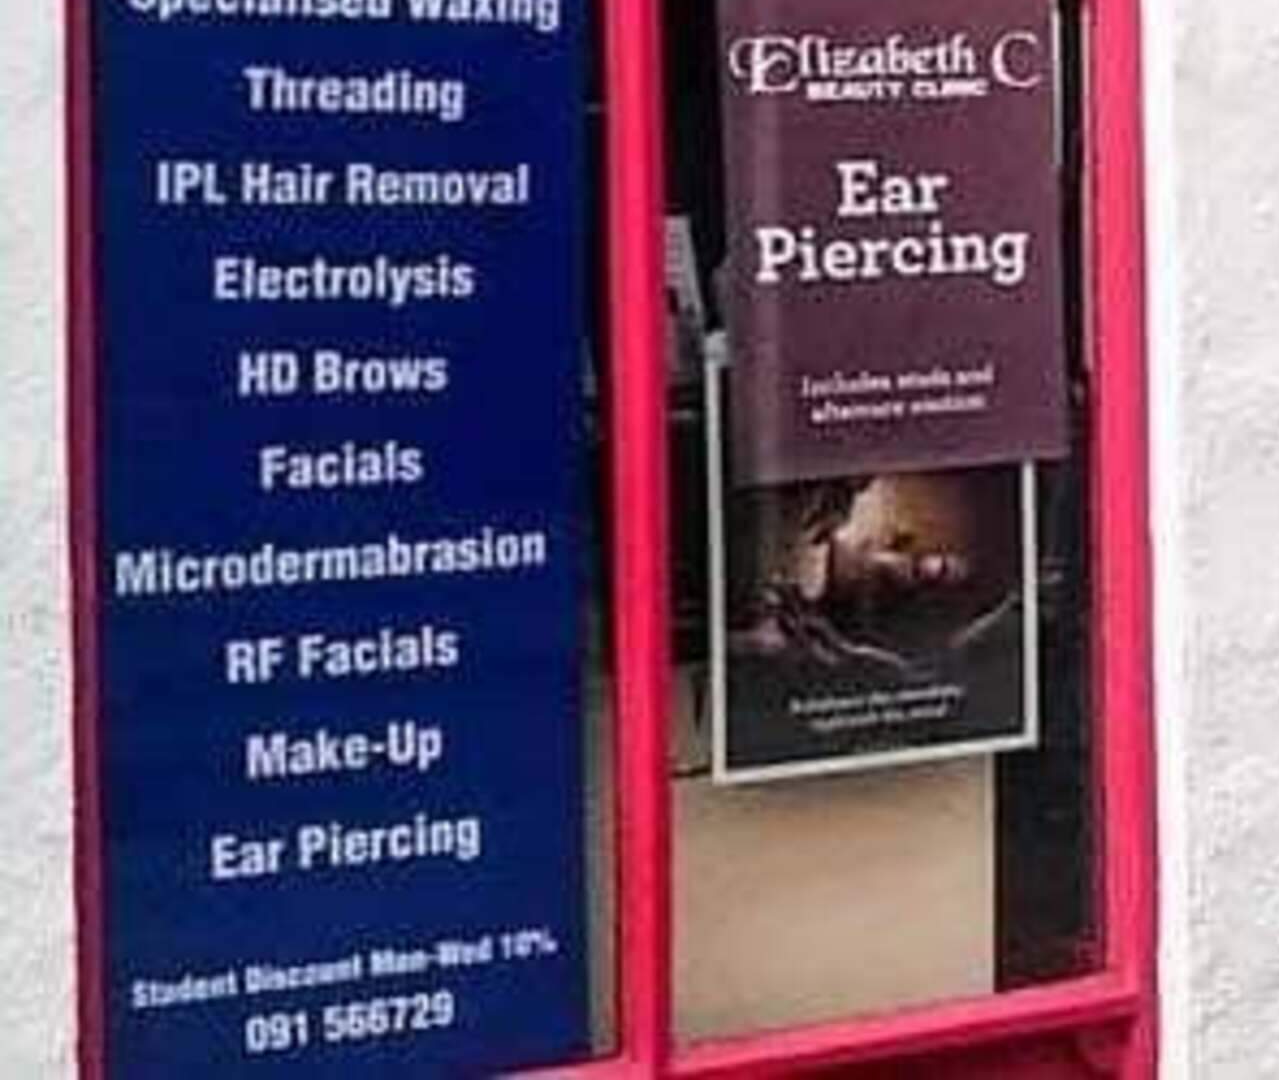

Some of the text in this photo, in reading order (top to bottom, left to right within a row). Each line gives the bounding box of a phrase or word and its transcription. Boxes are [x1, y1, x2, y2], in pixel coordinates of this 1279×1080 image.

[729, 31, 1042, 93] Elizabeth C
[244, 67, 465, 120] Threading
[806, 81, 904, 101] BEAUTY
[157, 162, 530, 206] IPL Hair Removal
[837, 160, 949, 217] Ear
[755, 221, 1029, 285] Piercing
[213, 257, 475, 308] Electrolysis
[238, 351, 448, 395] HD Brows
[260, 441, 424, 491] Facials
[115, 527, 546, 597] Microdermabrasion
[226, 626, 459, 683] RF Facials
[246, 722, 443, 780] Make-Up
[211, 811, 482, 879] Ear Piercing
[132, 967, 238, 1009] Student
[245, 954, 362, 995] Discount
[245, 990, 455, 1054] 091 566729
